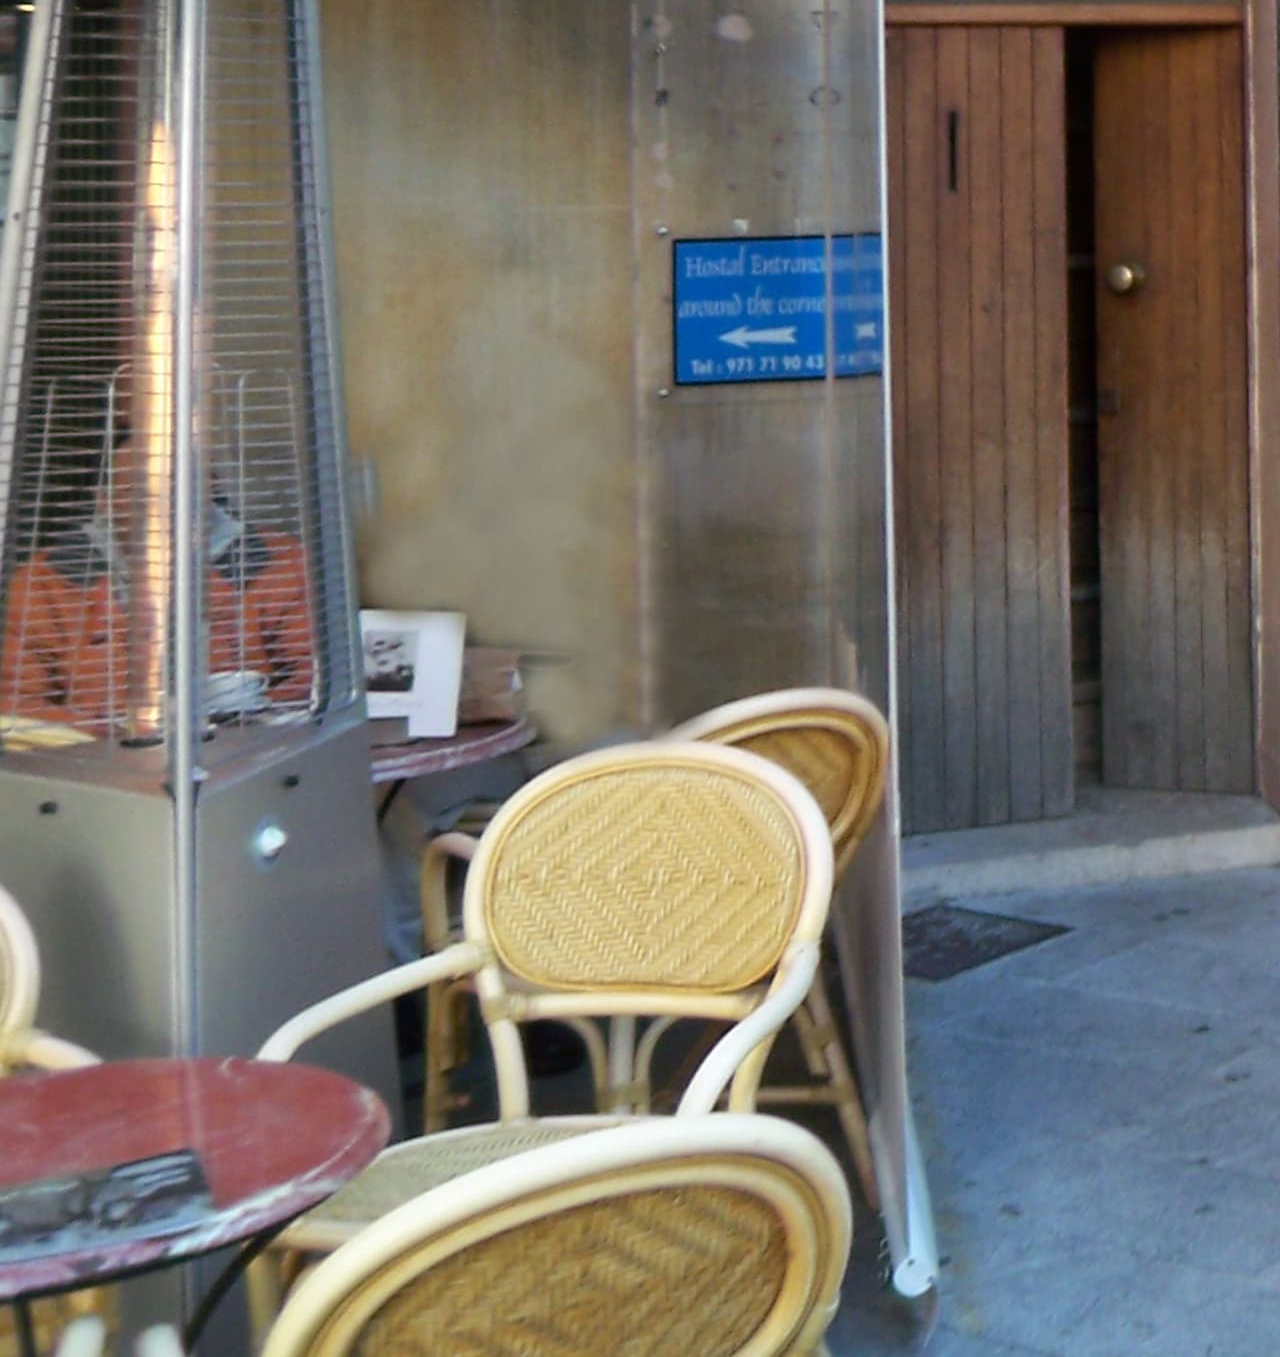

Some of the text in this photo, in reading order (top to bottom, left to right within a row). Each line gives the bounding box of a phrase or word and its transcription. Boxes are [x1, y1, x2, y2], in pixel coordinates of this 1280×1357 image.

[684, 246, 826, 278] Hostal Entranc
[679, 286, 826, 318] around the corne
